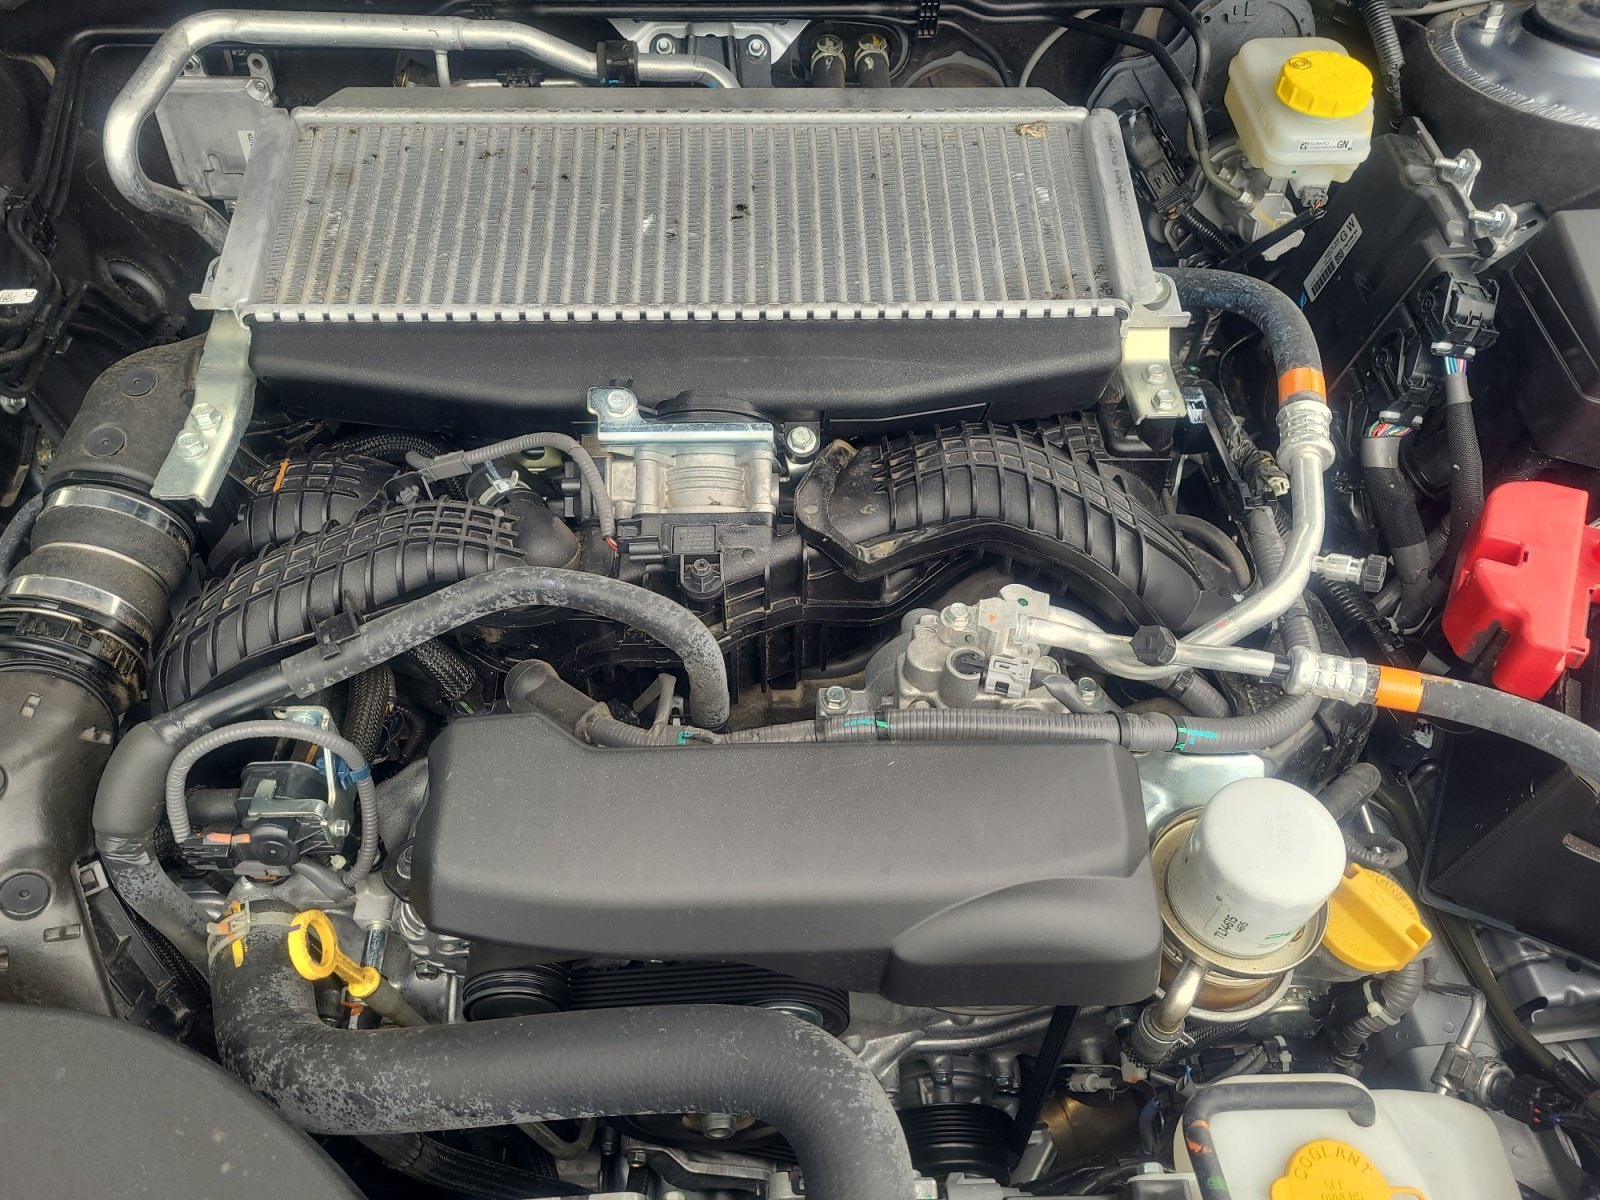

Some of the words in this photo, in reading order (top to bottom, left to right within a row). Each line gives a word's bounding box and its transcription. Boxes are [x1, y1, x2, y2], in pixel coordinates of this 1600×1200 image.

[1337, 140, 1350, 149] GN
[1213, 913, 1239, 940] TL14615
[1294, 1144, 1373, 1181] COOLANT
